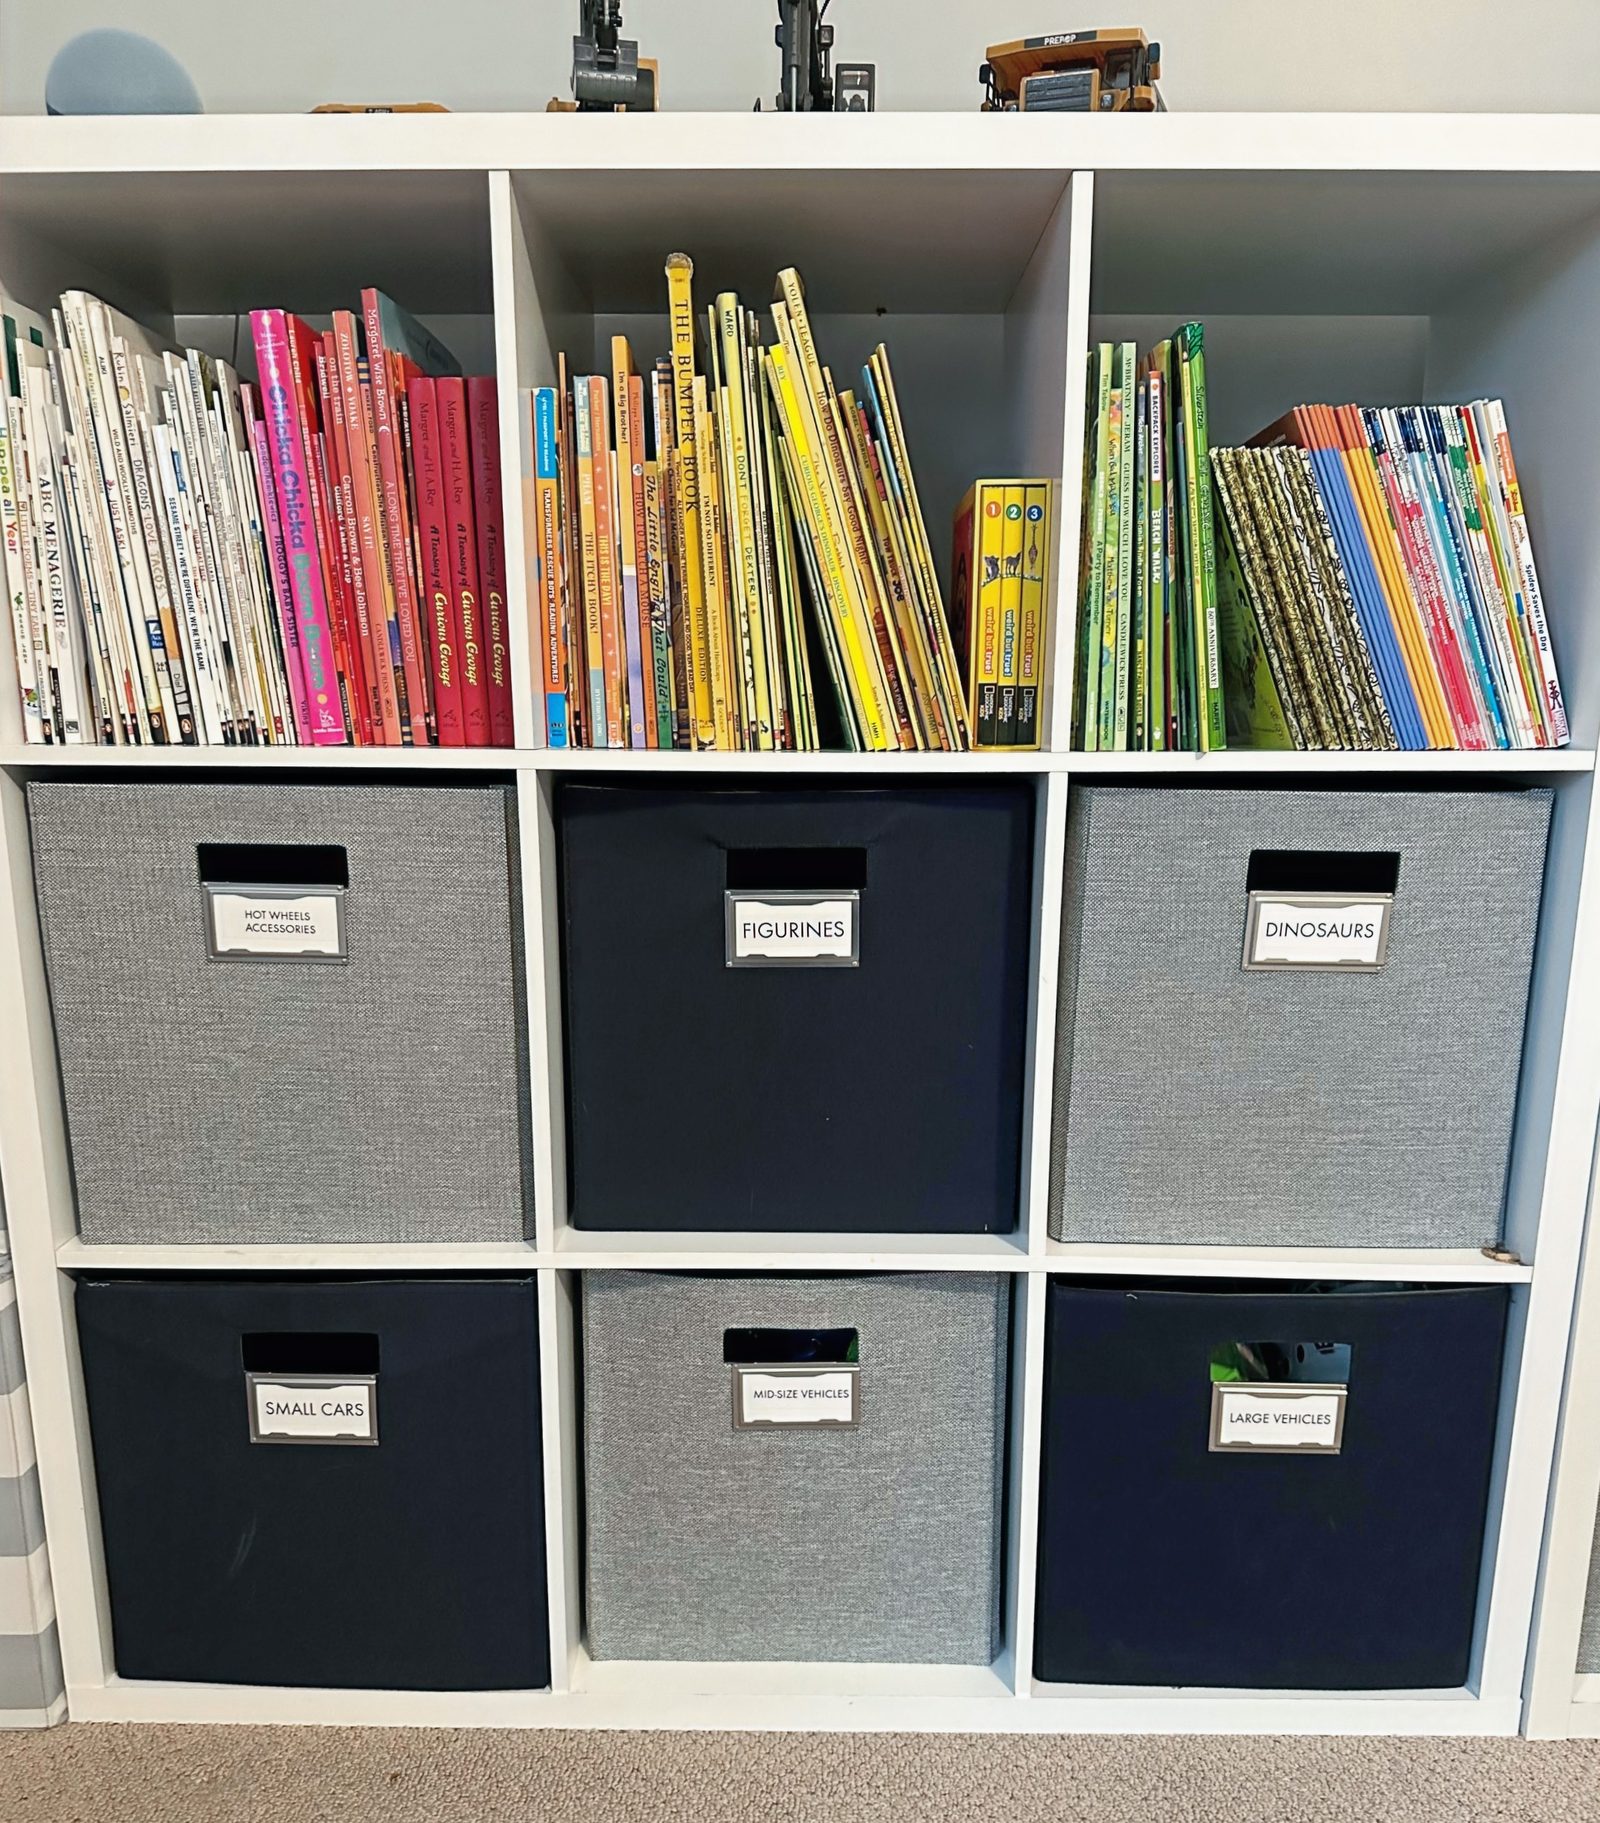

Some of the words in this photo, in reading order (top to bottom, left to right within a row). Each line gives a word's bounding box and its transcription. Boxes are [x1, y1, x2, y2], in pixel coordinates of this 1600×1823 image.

[366, 308, 381, 359] Margaret
[675, 300, 691, 344] THE
[724, 310, 735, 337] WARD
[787, 281, 804, 317] YOLEN
[799, 324, 816, 367] TEAGUE
[317, 355, 330, 399] Bridwell
[374, 361, 384, 386] Wise
[618, 371, 626, 384] I'm
[113, 352, 125, 383] Rubin
[122, 403, 138, 447] Salmieri
[377, 388, 388, 420] Brown
[617, 394, 627, 407] Big
[677, 355, 698, 445] BUMPER
[816, 390, 829, 414] How
[1194, 385, 1206, 430] Silverstein
[619, 409, 628, 445] Brother!
[822, 416, 834, 432] Do
[1151, 395, 1160, 435] BACKPACK
[1123, 423, 1132, 453] JERAM
[268, 385, 293, 465] Chicka
[281, 470, 308, 548] Chicka
[826, 433, 848, 484] Dinosaurs
[1152, 437, 1161, 475] EXPLORER
[132, 459, 151, 510] DRAGONS
[385, 481, 395, 490] A
[684, 456, 699, 513] BOOK
[736, 455, 747, 489] DON'T
[1123, 462, 1131, 492] GUESS
[39, 477, 52, 513] ABC
[342, 475, 354, 516] Carron
[645, 475, 657, 503] The
[839, 486, 854, 505] Say
[3, 498, 16, 517] all
[109, 499, 121, 521] JUST
[168, 497, 179, 525] SESAME
[387, 491, 398, 521] LONG
[543, 488, 554, 549] TRANSFORMERS
[635, 492, 645, 519] HOW
[704, 510, 712, 528] NOT
[739, 495, 752, 542] FORGET
[847, 505, 860, 533] Good
[990, 504, 996, 515] 1
[1010, 507, 1017, 518] 2
[1031, 508, 1038, 519] 3
[1122, 495, 1131, 517] HOW
[6, 521, 18, 554] Year
[20, 513, 31, 546] LITTLE
[114, 527, 126, 550] ASK!
[143, 515, 157, 546] LOVE
[173, 526, 184, 551] STREET
[346, 517, 360, 553] Brown
[391, 525, 402, 549] TIME
[636, 523, 646, 538] TO
[646, 505, 659, 554] Little
[705, 529, 713, 540] SO
[1122, 519, 1130, 546] MUCH
[1151, 509, 1162, 545] BEACH
[584, 532, 594, 557] THE
[599, 534, 609, 555] THIS
[853, 535, 869, 566] Night?
[25, 547, 35, 580] POEMS
[146, 551, 165, 590] TACOS
[179, 557, 189, 578] WE'RE
[273, 535, 287, 584] FROGGY'S
[352, 556, 362, 565] &
[393, 550, 405, 575] THAT
[546, 549, 555, 579] RESCUE
[600, 556, 610, 565] IS
[636, 542, 648, 576] CATCH
[706, 542, 716, 587] DIFFERENT
[744, 546, 756, 596] DEXTER!
[1094, 547, 1103, 571] Party
[1120, 558, 1129, 579] LOVE
[1152, 548, 1161, 584] WALK
[44, 520, 66, 628] MENAGERIE
[354, 567, 366, 588] Bee
[395, 576, 408, 598] I'VE
[586, 559, 596, 595] ITCHY
[600, 566, 611, 584] THE
[639, 579, 649, 587] A
[648, 558, 664, 611] Engine
[1095, 572, 1102, 581] to
[1105, 556, 1115, 591] Matthew
[1525, 564, 1535, 593] Spidey
[28, 591, 38, 613] TINY
[281, 588, 293, 613] BABY
[601, 585, 612, 606] DAY!
[1093, 581, 1101, 625] Remember
[1105, 593, 1115, 608] Paul
[1120, 581, 1129, 601] YOU
[356, 589, 370, 636] Johnson
[400, 602, 412, 638] LOVED
[434, 592, 449, 642] Curious
[460, 590, 475, 640] Curious
[489, 591, 504, 641] Curious
[549, 602, 557, 635] READING
[588, 599, 598, 635] BOOK!
[640, 591, 651, 629] MOUSE
[1531, 594, 1542, 619] Saves
[31, 615, 41, 638] EARS
[189, 616, 199, 637] WE'RE
[286, 616, 299, 648] SISTER
[985, 607, 996, 634] weird
[1004, 610, 1015, 637] weird
[1024, 610, 1035, 637] weird
[1105, 609, 1114, 635] Turner
[1536, 620, 1545, 635] the
[193, 639, 202, 650] THE
[651, 619, 668, 651] That
[985, 635, 994, 650] but
[1004, 637, 1014, 653] but
[1024, 637, 1034, 653] but
[1119, 613, 1128, 672] CANDLEWICK
[1539, 636, 1549, 652] Day
[196, 651, 205, 671] SAME
[404, 639, 415, 663] YOU
[465, 641, 478, 686] George
[492, 642, 507, 687] George
[550, 636, 559, 684] ADVENTURES
[984, 651, 994, 675] true!
[1209, 628, 1217, 686] ANNIVERSARY!
[438, 643, 451, 688] George
[656, 657, 668, 699] Could
[1003, 653, 1013, 677] true!
[1023, 654, 1033, 678] true!
[1117, 674, 1126, 700] PRESS
[1212, 701, 1220, 731] HARPER
[1554, 711, 1567, 737] MARVEL
[244, 910, 266, 921] HOT
[268, 911, 311, 922] WHEELS
[244, 923, 316, 935] ACCESSORIES
[743, 921, 845, 939] FIGURINES
[1265, 922, 1375, 939] DINOSAURS
[753, 1389, 798, 1399] MID-SIZE
[801, 1389, 850, 1400] VEHICLES
[265, 1401, 317, 1416] SMALL
[321, 1403, 365, 1418] CARS
[1229, 1413, 1270, 1425] LARGE
[1273, 1413, 1332, 1426] VEHICLES
